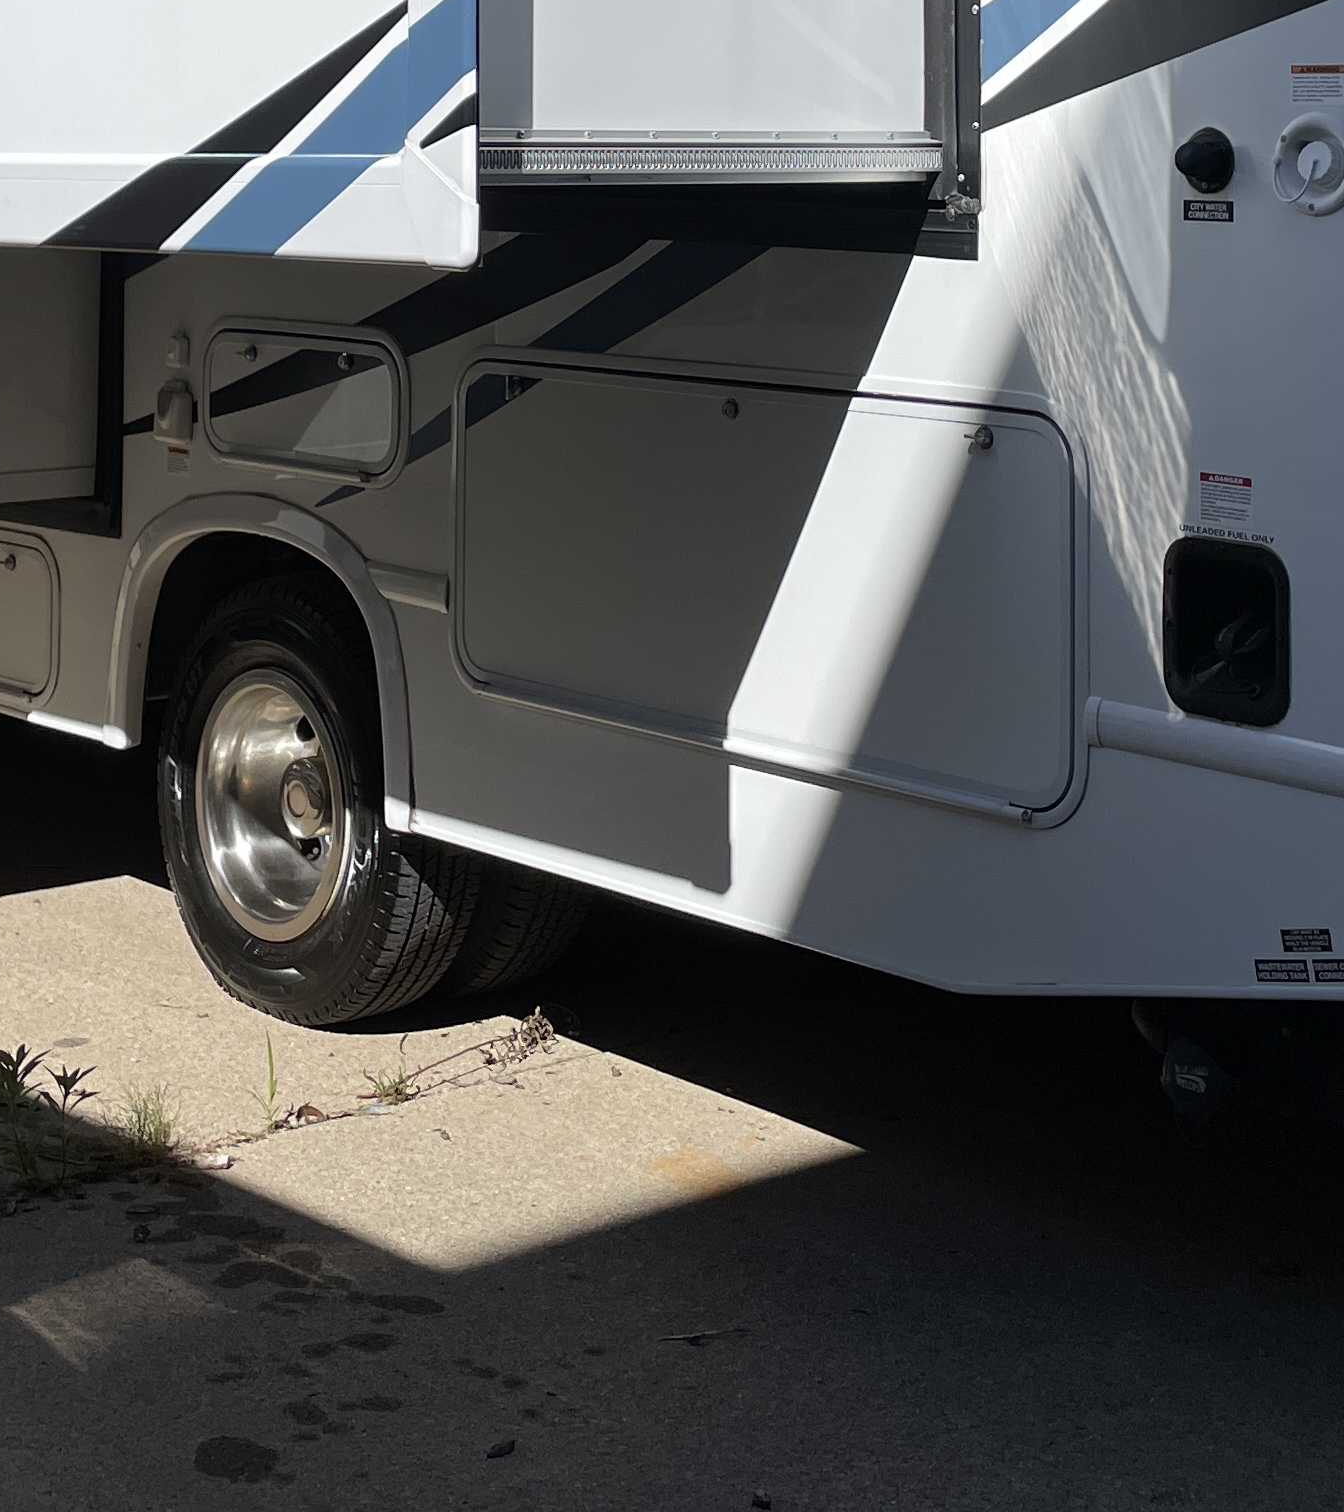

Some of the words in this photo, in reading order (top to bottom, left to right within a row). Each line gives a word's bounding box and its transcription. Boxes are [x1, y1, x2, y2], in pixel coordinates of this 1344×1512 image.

[1214, 474, 1244, 485] DANGER
[1179, 524, 1226, 538] UNLEADED
[1227, 530, 1249, 542] FUEL
[1251, 533, 1275, 544] ONLY
